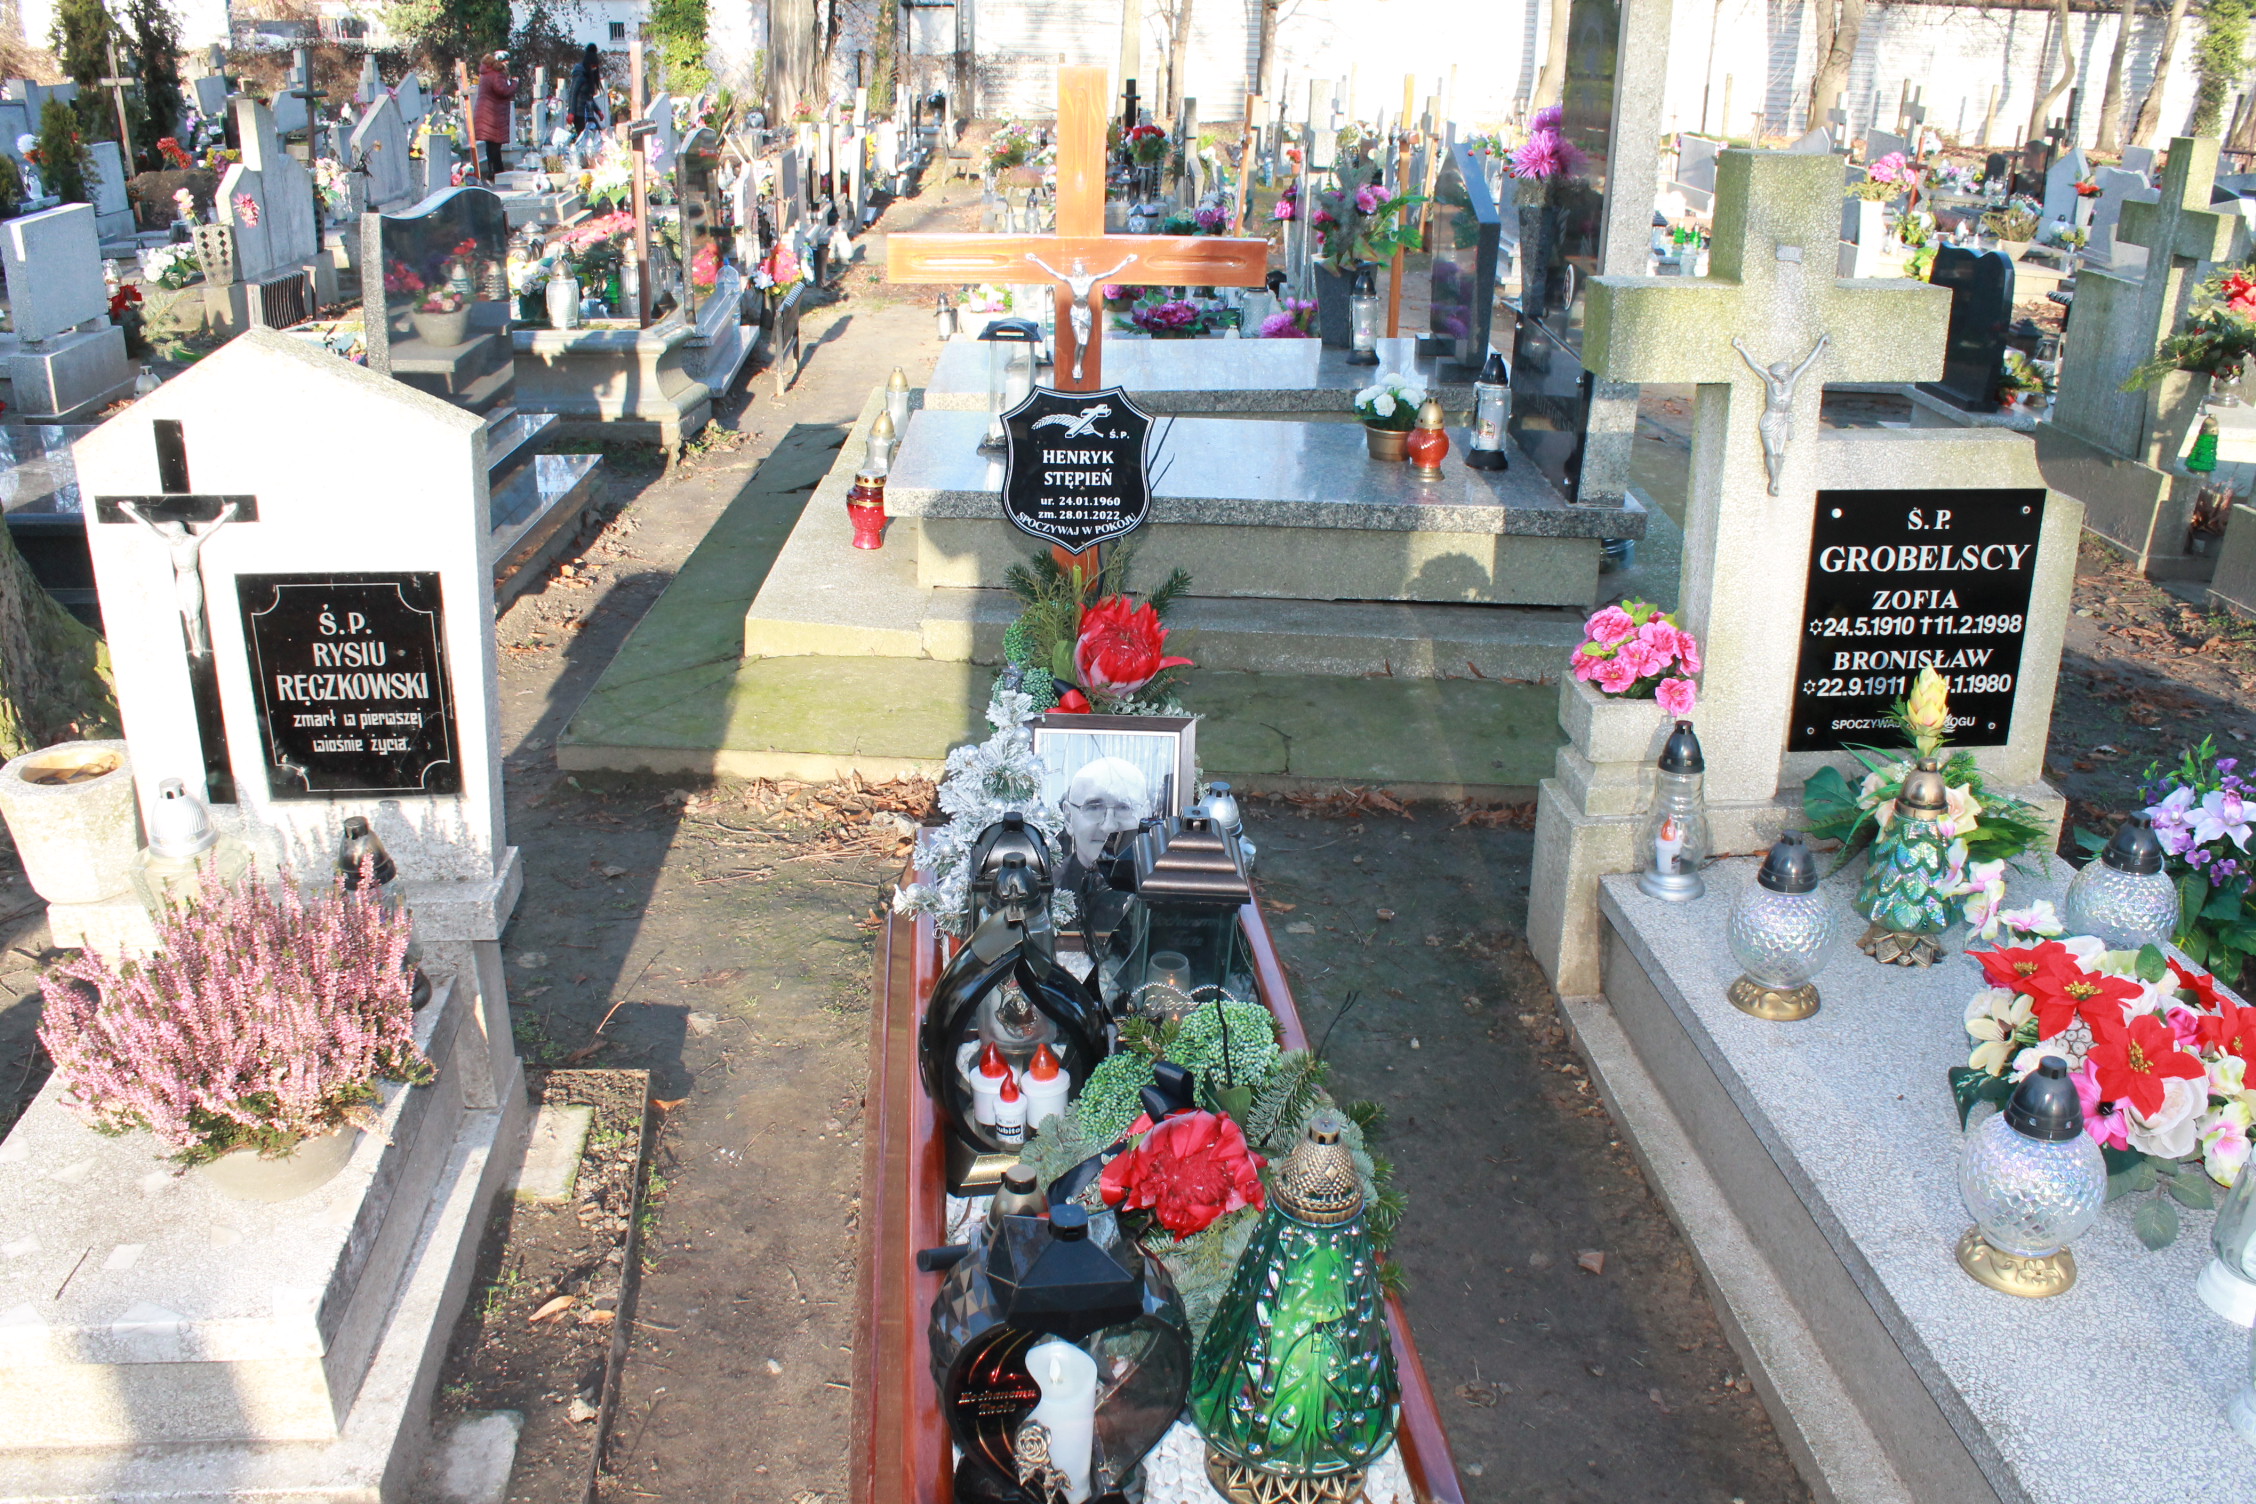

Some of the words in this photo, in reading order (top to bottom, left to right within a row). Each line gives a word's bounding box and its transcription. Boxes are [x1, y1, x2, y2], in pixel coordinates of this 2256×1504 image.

[1042, 450, 1114, 464] HENRYK
[1044, 468, 1113, 489] STĘPIEŃ
[1040, 497, 1055, 506] ur.
[1059, 496, 1121, 506] 24.01.1960
[1016, 511, 1080, 535] SPOCZYWAJ
[1082, 527, 1093, 535] W
[1095, 512, 1137, 534] POKOJU
[1038, 511, 1057, 519] zm.
[1059, 510, 1120, 520] 28.01.2022
[1819, 544, 2031, 573] GROBELSCY
[1872, 589, 1959, 610] ZOFIA
[313, 642, 386, 667] RYSIU
[1832, 649, 1994, 671] BRONISŁAW
[276, 672, 430, 706] RĘCZKOWSKI
[293, 709, 337, 728] zmarł
[344, 714, 356, 726] w
[360, 707, 423, 730] pierwszej
[313, 734, 364, 752] wiośnie
